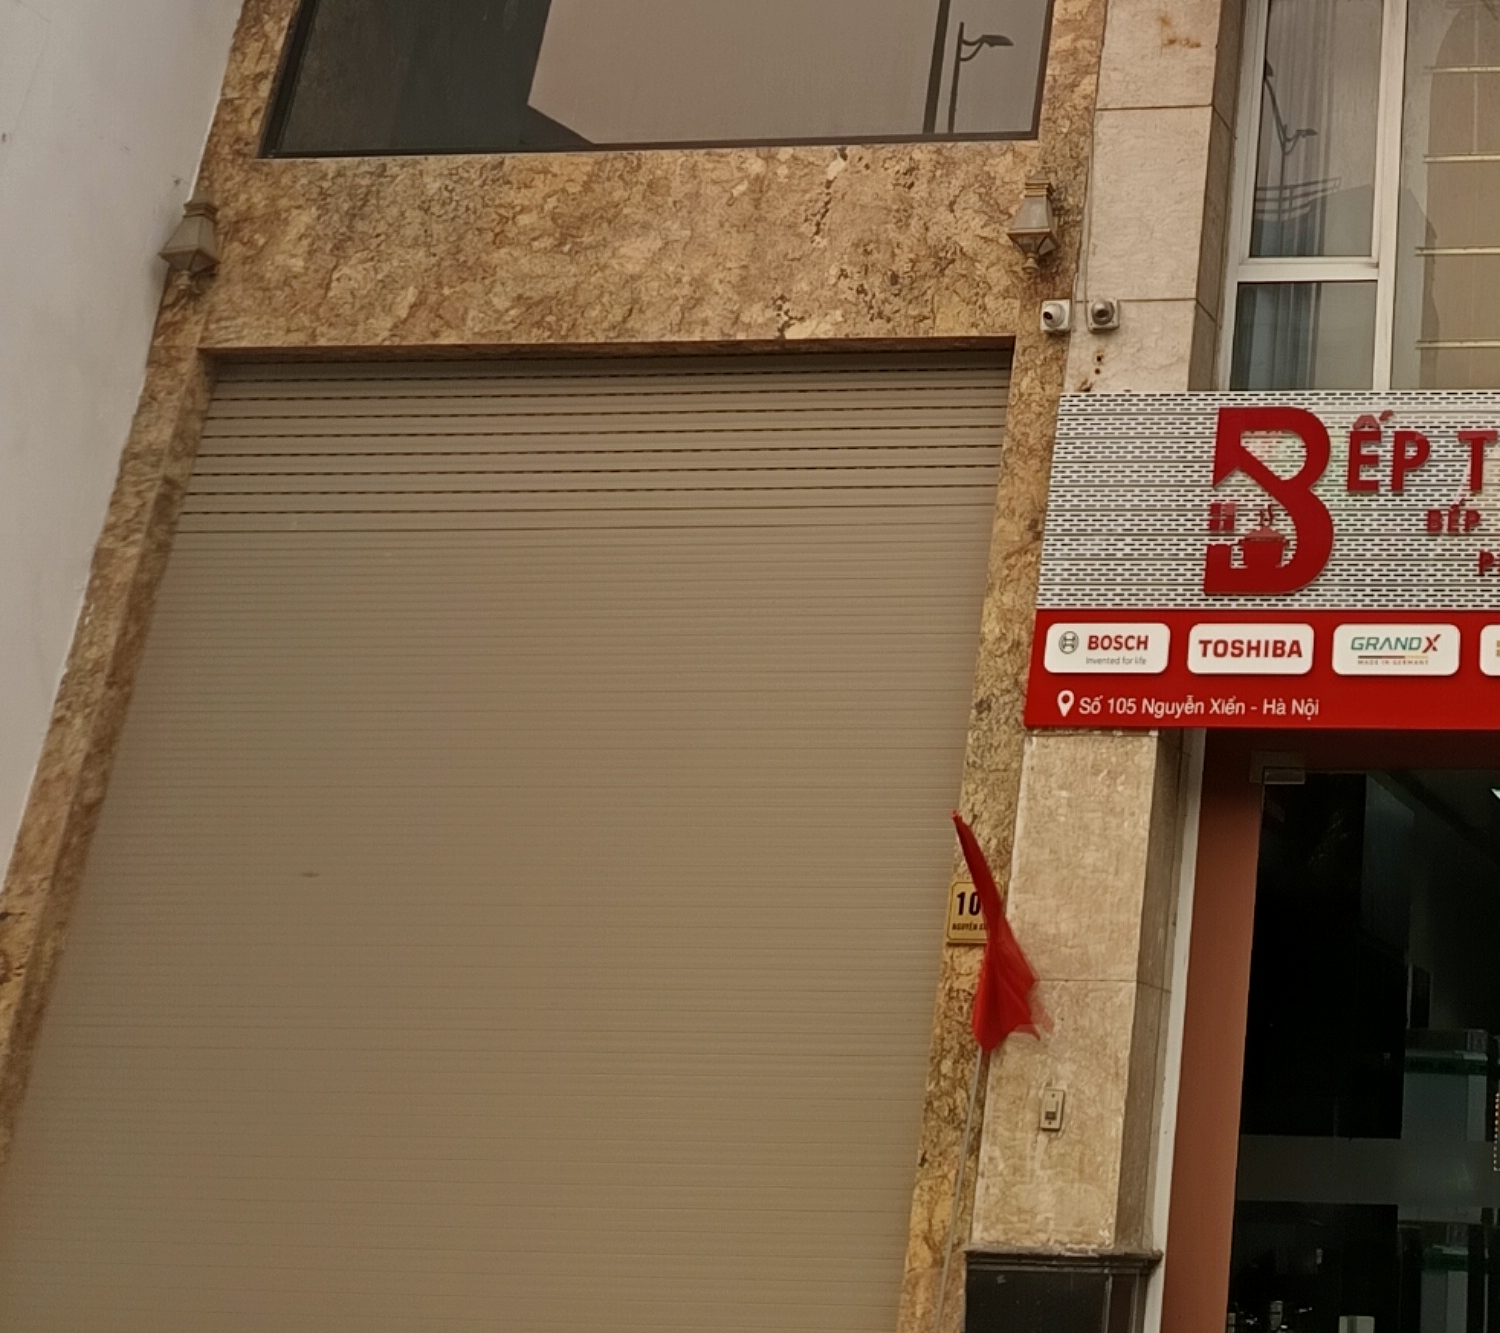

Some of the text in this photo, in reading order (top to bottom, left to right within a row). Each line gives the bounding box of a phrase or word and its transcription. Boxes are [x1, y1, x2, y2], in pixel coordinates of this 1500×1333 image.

[1426, 497, 1482, 535] BẾP
[1087, 634, 1149, 652] BOSCH
[1198, 638, 1303, 659] TOSHIBA
[1121, 655, 1147, 666] for life
[1078, 694, 1320, 720] Số 105 Nguyễn Xiển Hà Nội
